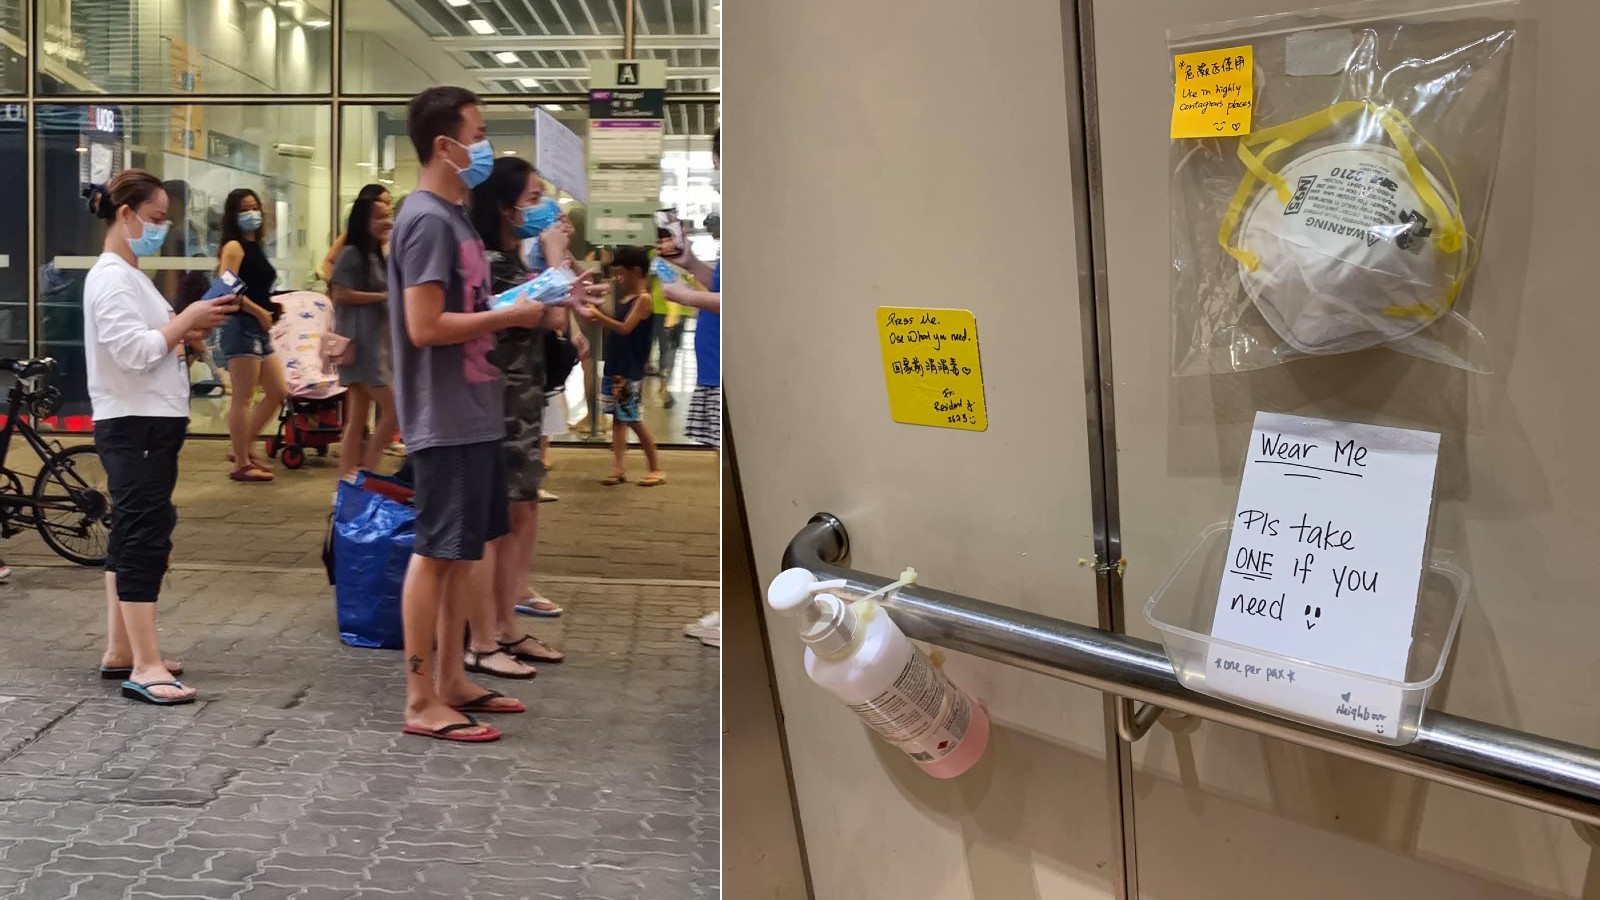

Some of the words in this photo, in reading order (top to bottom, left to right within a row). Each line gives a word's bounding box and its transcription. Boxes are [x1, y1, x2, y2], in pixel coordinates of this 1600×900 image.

[620, 66, 635, 83] A
[1215, 83, 1242, 99] highly
[1226, 99, 1252, 115] places
[96, 107, 114, 133] UOB
[1288, 179, 1312, 211] N95
[1305, 217, 1366, 240] WARNING
[933, 334, 946, 351] you
[1261, 433, 1318, 460] Wear
[1334, 439, 1368, 467] Me
[1238, 509, 1280, 536] Pls
[1290, 513, 1355, 551] take
[1235, 547, 1273, 574] ONE
[1293, 553, 1314, 584] if
[1332, 566, 1378, 597] you
[1231, 593, 1286, 621] need
[1244, 664, 1262, 678] per
